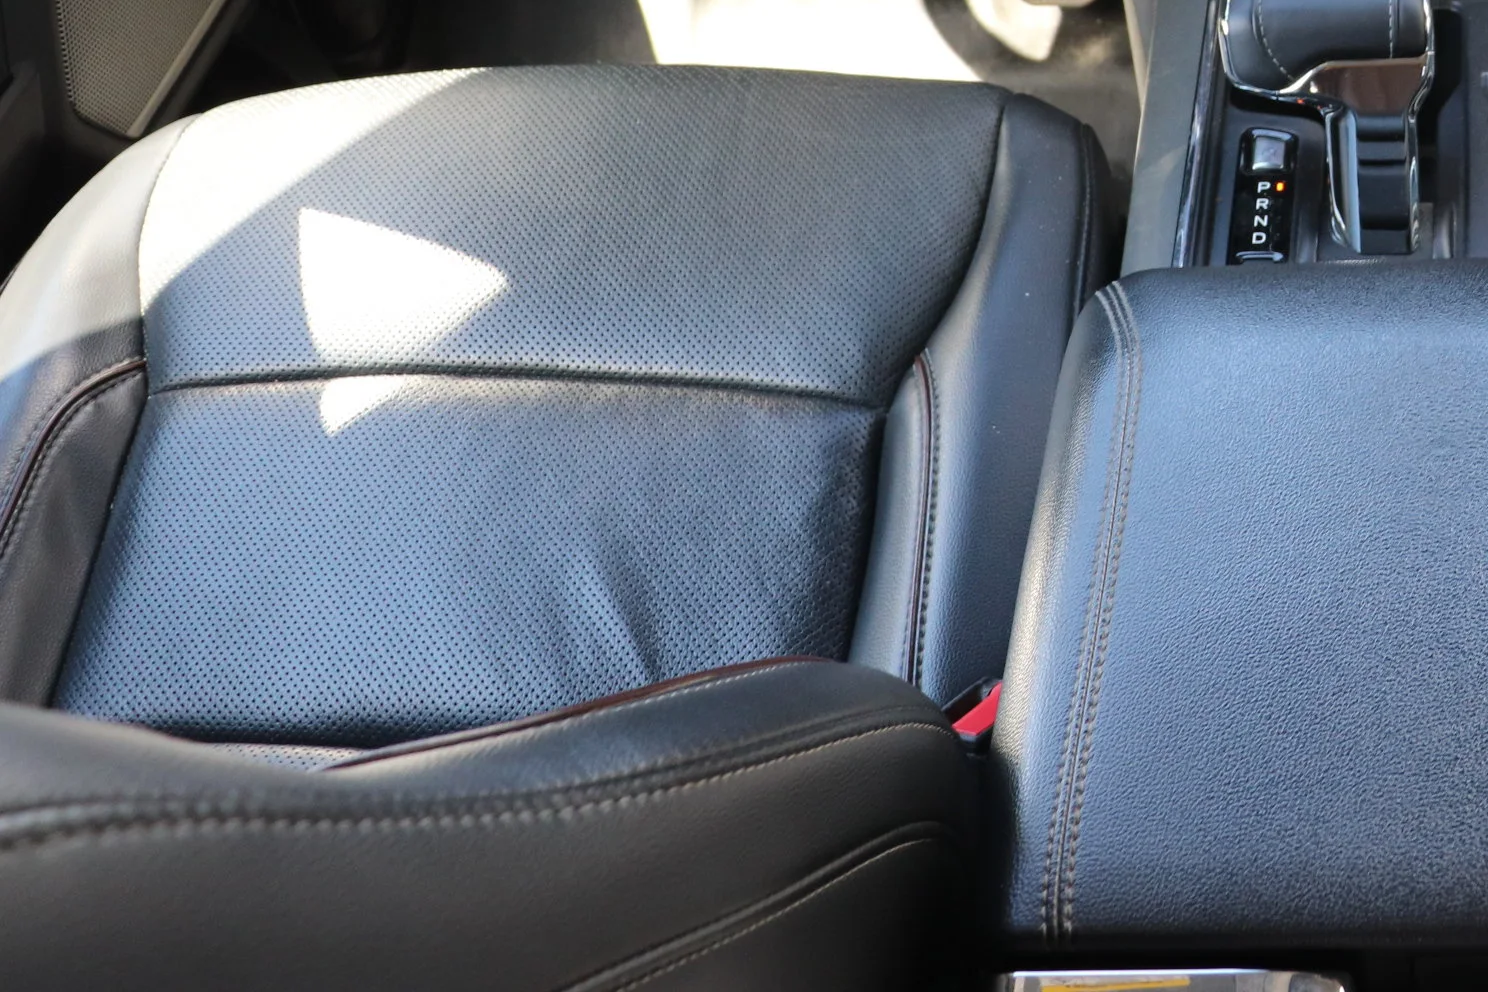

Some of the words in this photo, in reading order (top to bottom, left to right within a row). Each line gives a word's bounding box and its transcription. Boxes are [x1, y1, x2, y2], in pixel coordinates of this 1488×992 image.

[1256, 181, 1271, 194] P
[1255, 198, 1270, 210] R
[1253, 214, 1269, 227] N
[1251, 231, 1267, 245] D
